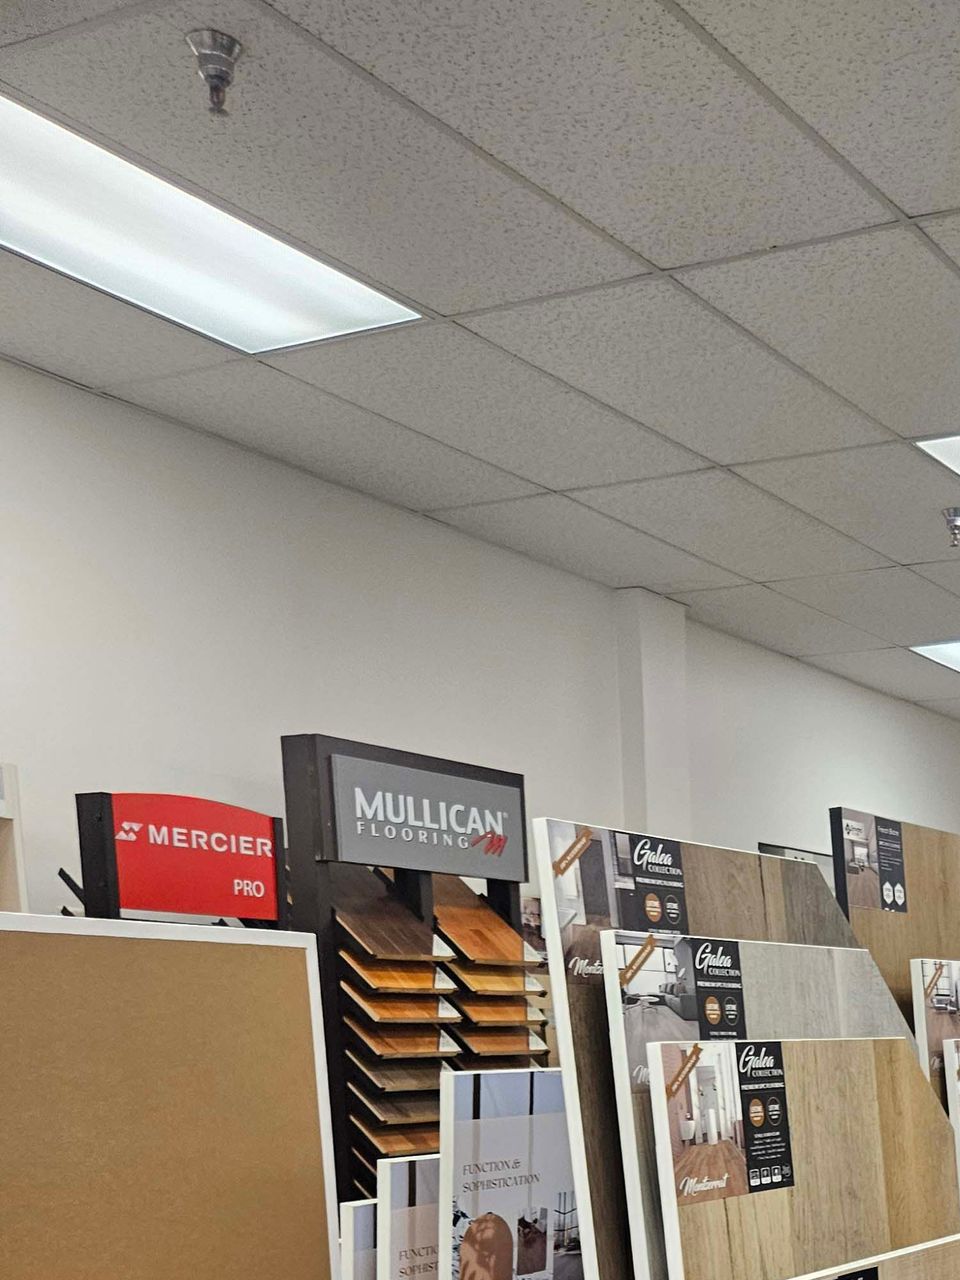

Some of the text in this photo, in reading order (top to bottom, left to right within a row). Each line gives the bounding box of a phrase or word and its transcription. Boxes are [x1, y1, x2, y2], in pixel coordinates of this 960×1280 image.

[354, 788, 503, 834] MULLICAN
[149, 824, 273, 858] MERCIER
[357, 821, 469, 850] FLOORING
[633, 839, 673, 870] Galea
[648, 864, 682, 876] COLLECTION
[233, 879, 265, 898] PRO
[695, 943, 733, 975] Galea
[708, 967, 741, 977] COLLECTION
[739, 1045, 774, 1077] Galea
[751, 1069, 783, 1077] COLLECTION
[463, 1160, 511, 1175] FUNCTION
[463, 1174, 541, 1193] SOPHISTICATION
